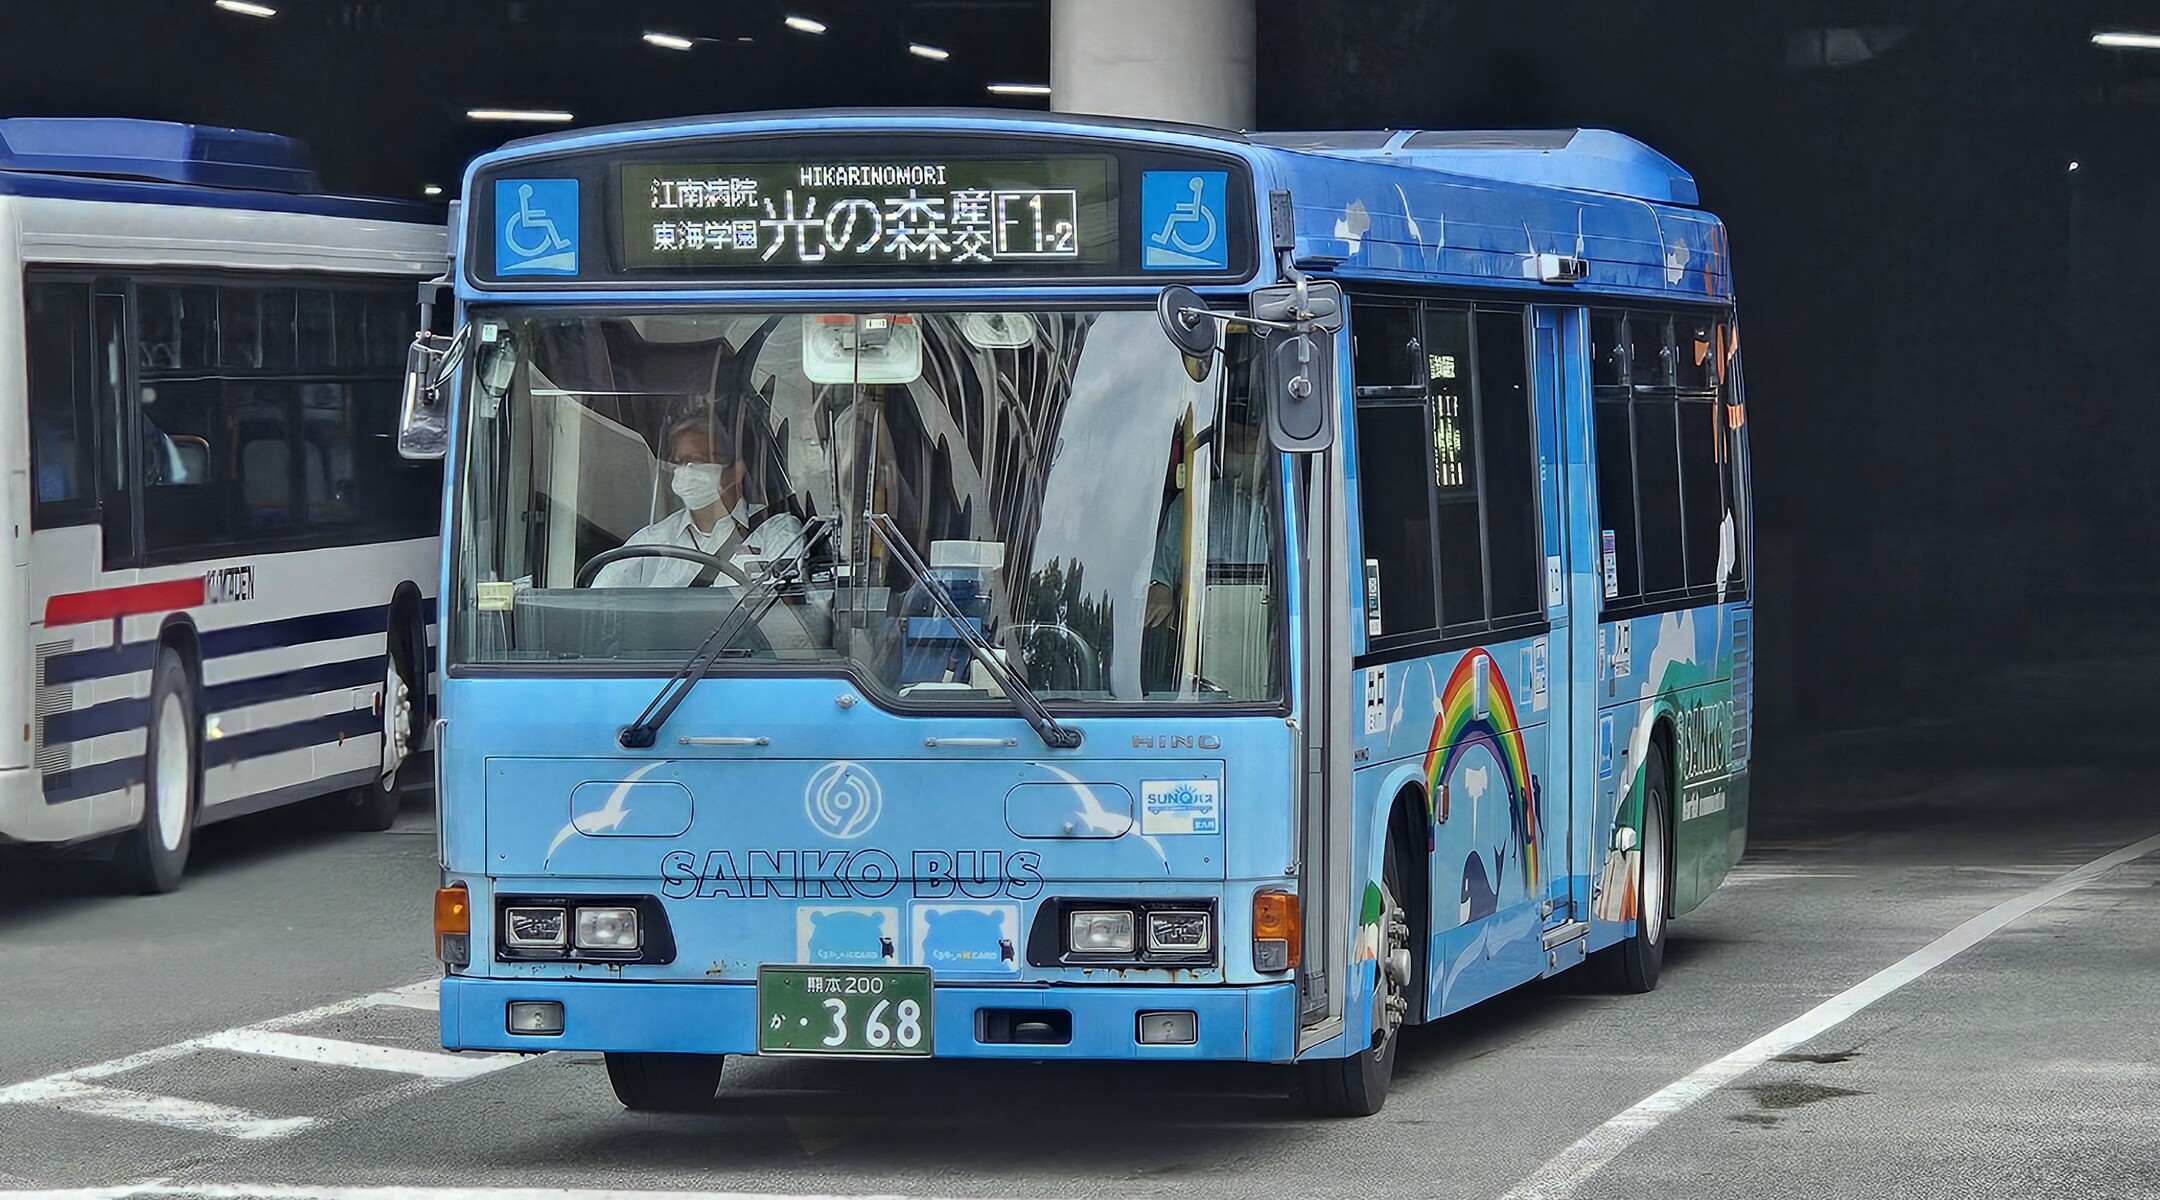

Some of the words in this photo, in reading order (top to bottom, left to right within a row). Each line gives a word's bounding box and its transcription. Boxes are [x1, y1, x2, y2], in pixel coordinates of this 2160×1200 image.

[800, 166, 947, 186] HIKARINOMORI
[650, 178, 758, 208] 江南病院
[653, 220, 758, 250] 東海学園
[760, 188, 951, 262] 光の森
[949, 187, 993, 262] 産交
[998, 194, 1074, 252] F1-2
[1131, 734, 1221, 750] HINO
[660, 848, 899, 900] SANKO
[911, 849, 1045, 901] BUS
[769, 1013, 787, 1030] か
